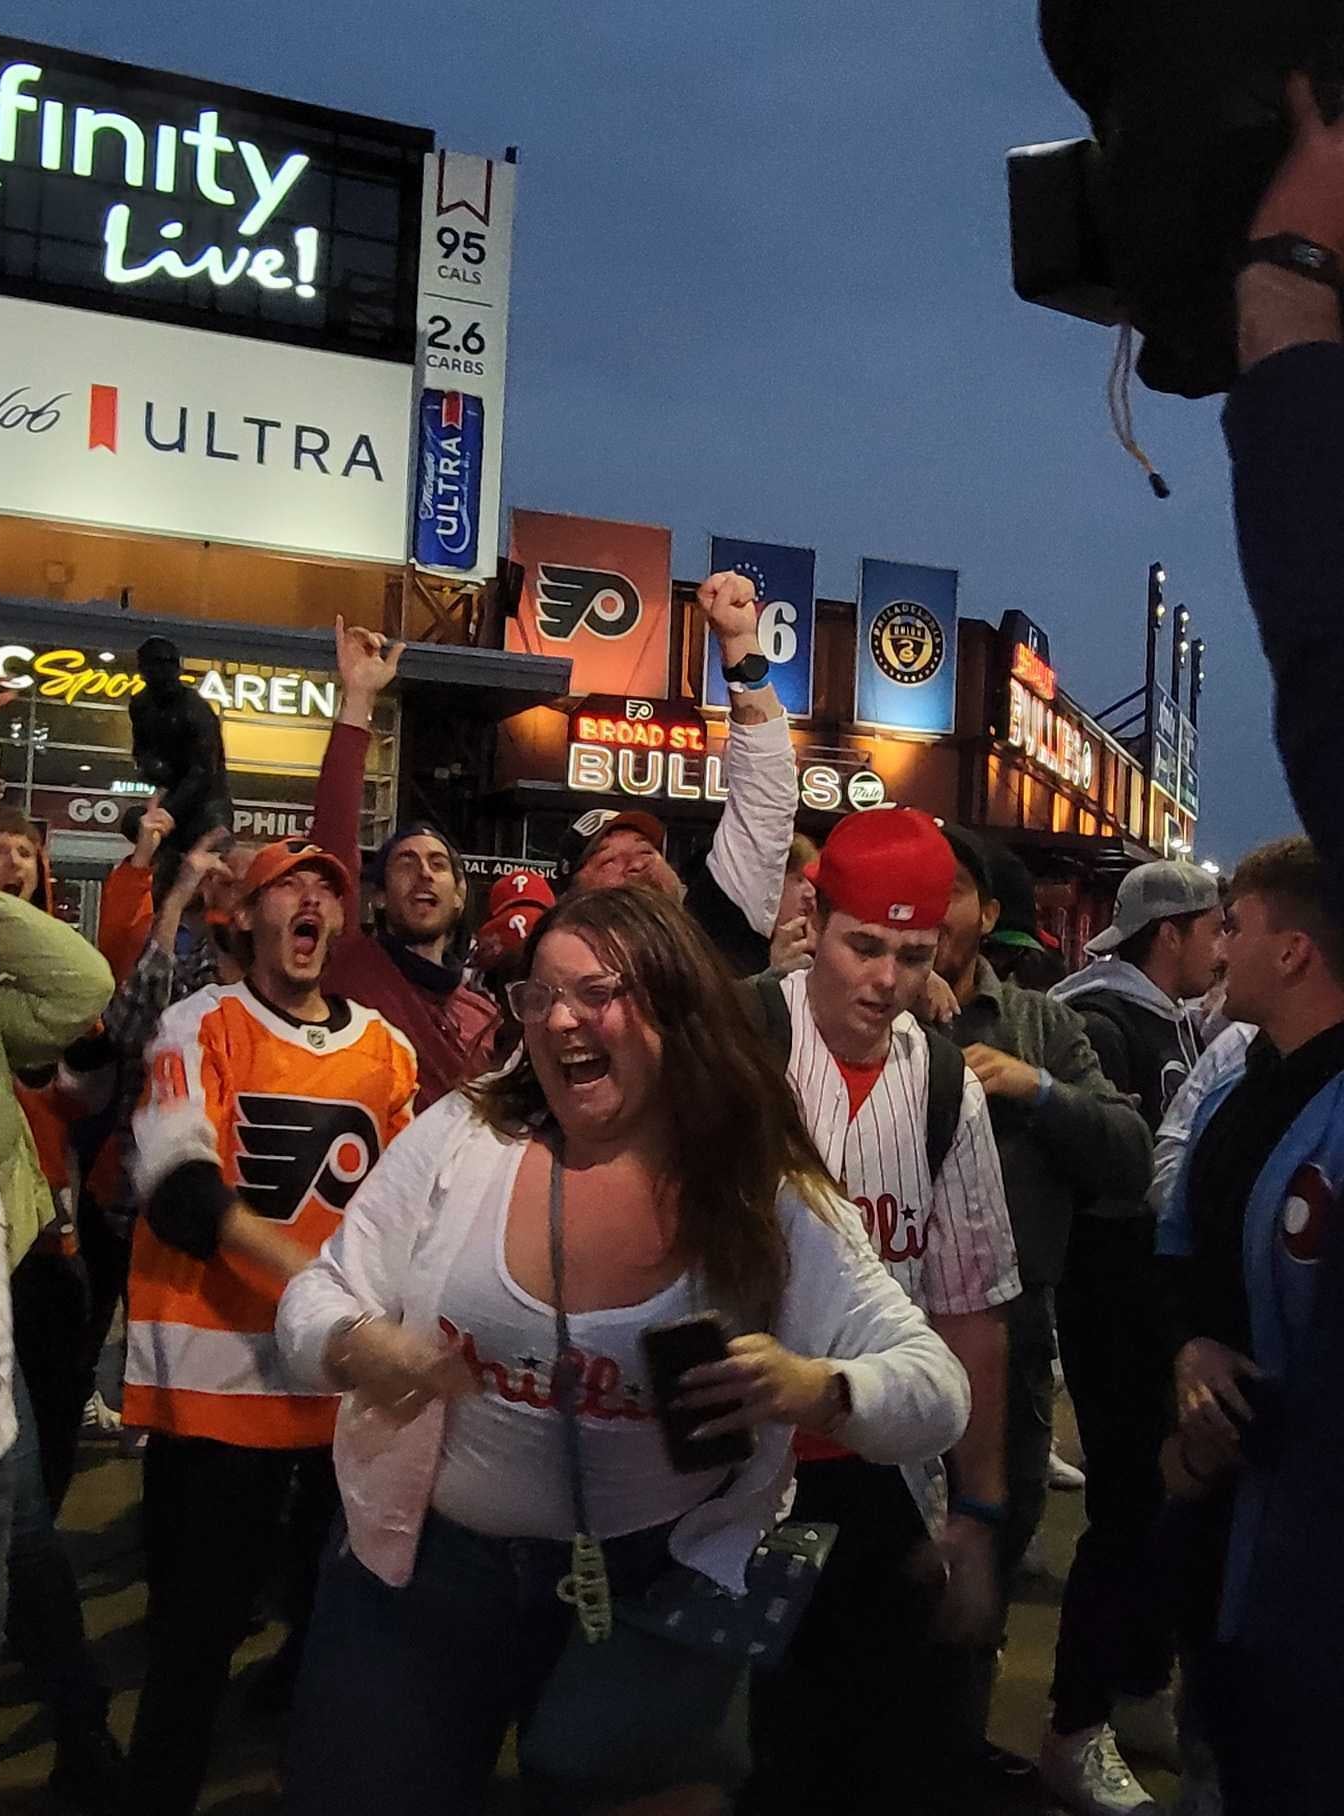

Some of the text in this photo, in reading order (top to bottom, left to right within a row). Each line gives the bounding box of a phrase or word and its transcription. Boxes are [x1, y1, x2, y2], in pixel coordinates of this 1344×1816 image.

[104, 203, 319, 299] Live!
[437, 227, 486, 265] 95
[438, 265, 482, 285] CALS
[427, 315, 485, 355] 2.6
[426, 354, 484, 376] CARBS
[144, 400, 385, 482] ULTRA
[435, 435, 462, 536] ULTRA
[198, 669, 336, 718] AREN
[579, 716, 664, 748] BROAD
[568, 743, 842, 812] BULLS
[68, 798, 120, 824] GO
[512, 875, 529, 893] P
[508, 914, 528, 939] P
